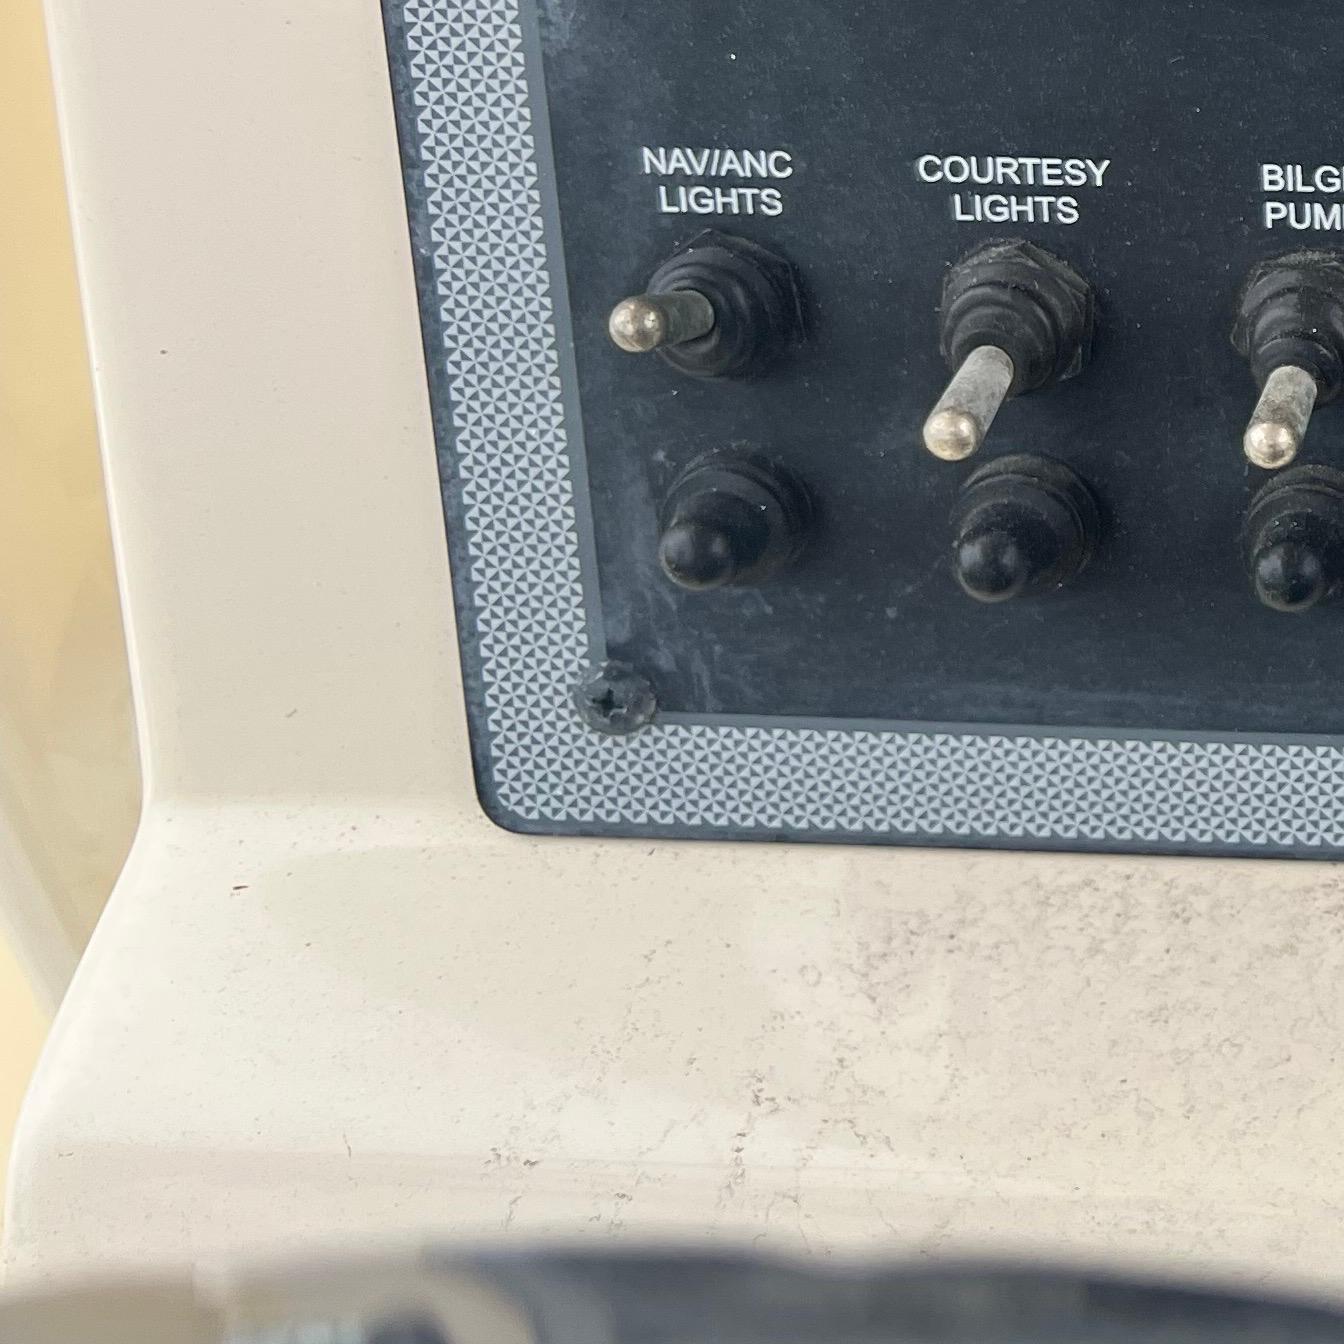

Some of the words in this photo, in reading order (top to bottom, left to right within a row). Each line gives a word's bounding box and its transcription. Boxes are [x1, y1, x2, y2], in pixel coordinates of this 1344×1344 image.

[642, 146, 793, 178] NAV/ANC
[918, 154, 1111, 187] COURTESY
[659, 185, 783, 216] LIGHTS
[953, 193, 1079, 224] LIGHTS
